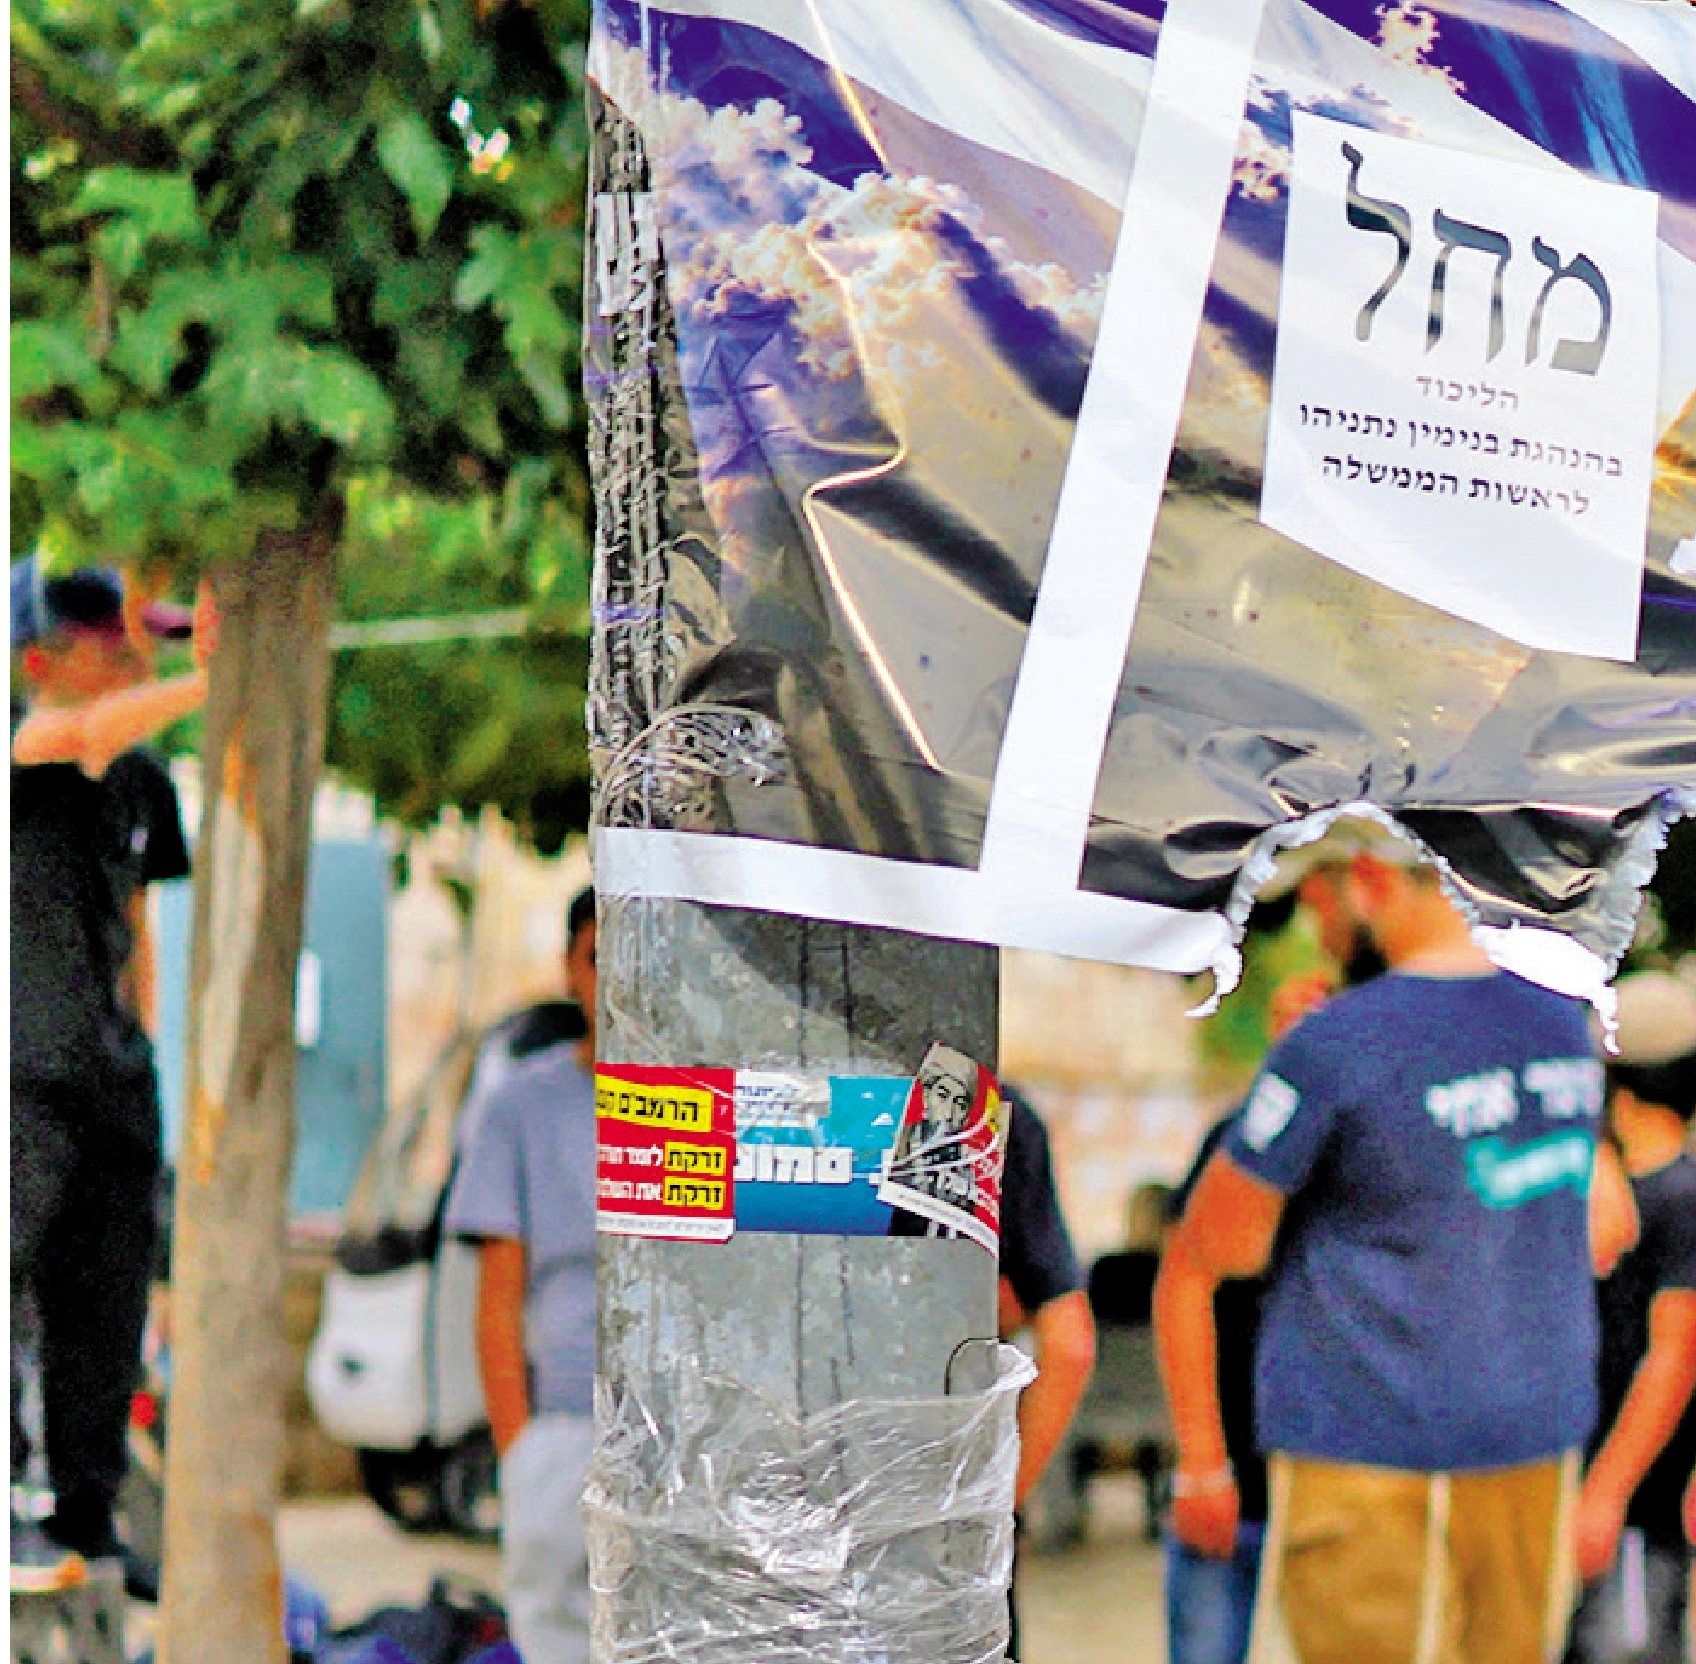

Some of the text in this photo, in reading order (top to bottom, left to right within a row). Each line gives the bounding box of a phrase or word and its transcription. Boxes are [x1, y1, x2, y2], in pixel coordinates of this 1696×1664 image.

[1341, 141, 1612, 375] מחל
[1416, 375, 1518, 410] הליכוד
[1300, 404, 1623, 476] בהנהגת בנימין נתניהו
[1323, 454, 1589, 514] לראשות הממשלה
[668, 1151, 721, 1171] זרקת
[668, 1184, 721, 1206] זרקת
